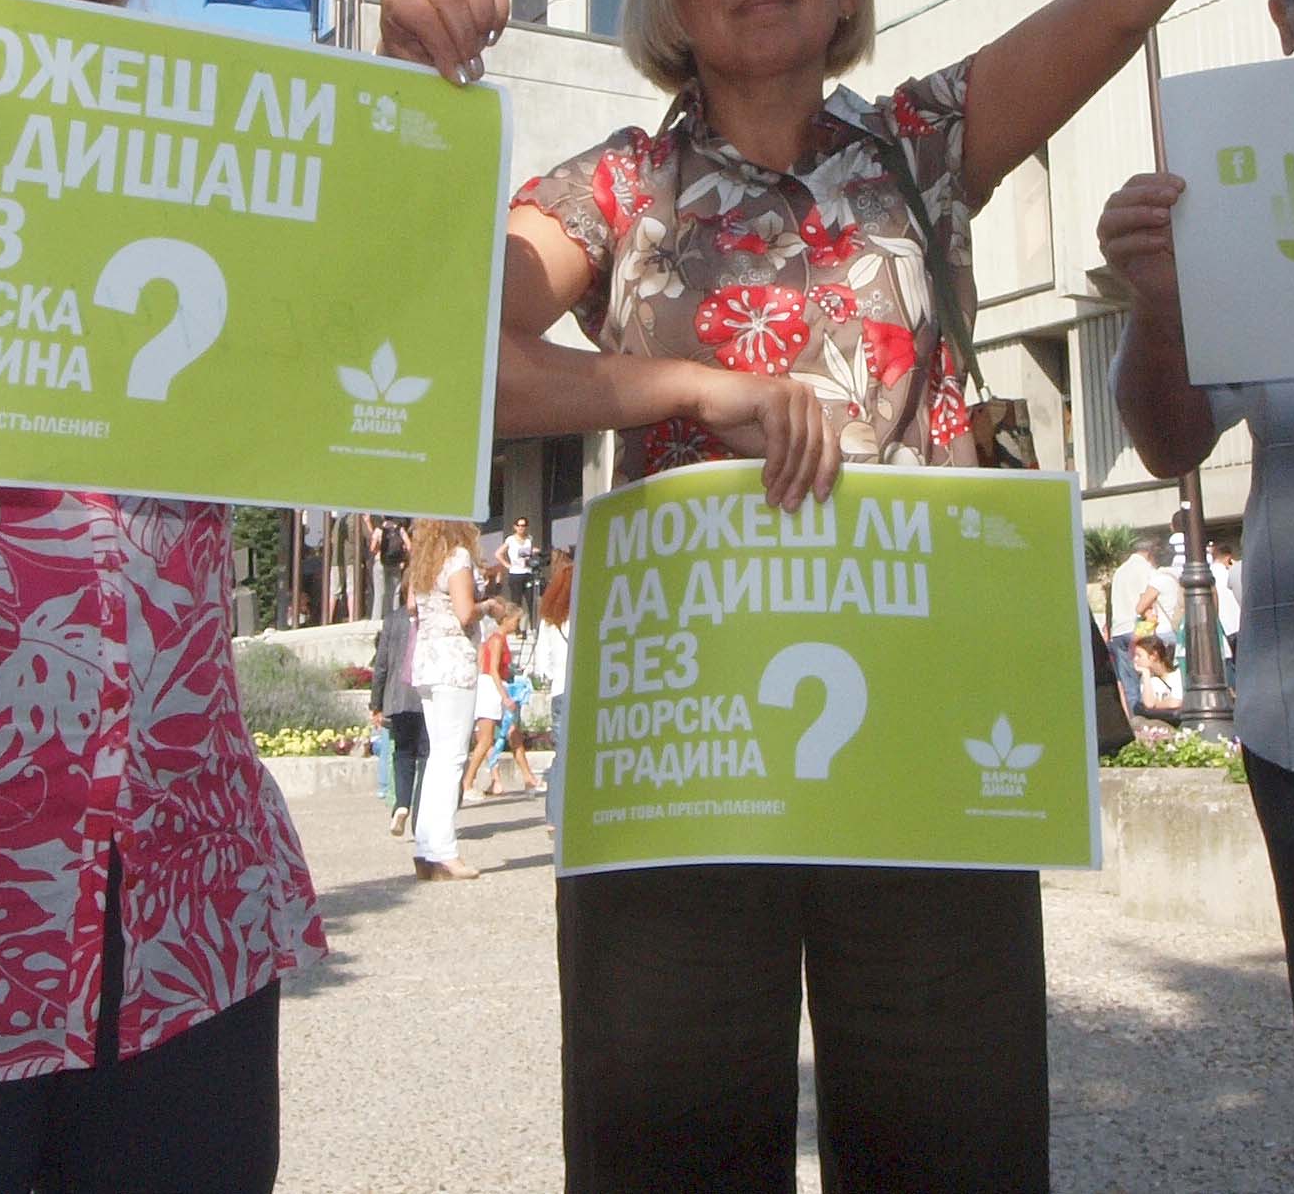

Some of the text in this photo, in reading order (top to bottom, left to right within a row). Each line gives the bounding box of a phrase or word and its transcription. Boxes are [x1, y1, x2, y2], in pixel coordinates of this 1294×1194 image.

[234, 71, 337, 146] ЛИ
[1, 113, 323, 223] ДИШАШ
[606, 493, 837, 568] МОЖЕШ
[852, 497, 932, 554] ЛИ
[598, 557, 930, 641] ДА ДИШАШ
[598, 631, 700, 699] БЕЗ
[595, 694, 753, 744] МОРСКА
[594, 739, 767, 790] ГРАДИНА
